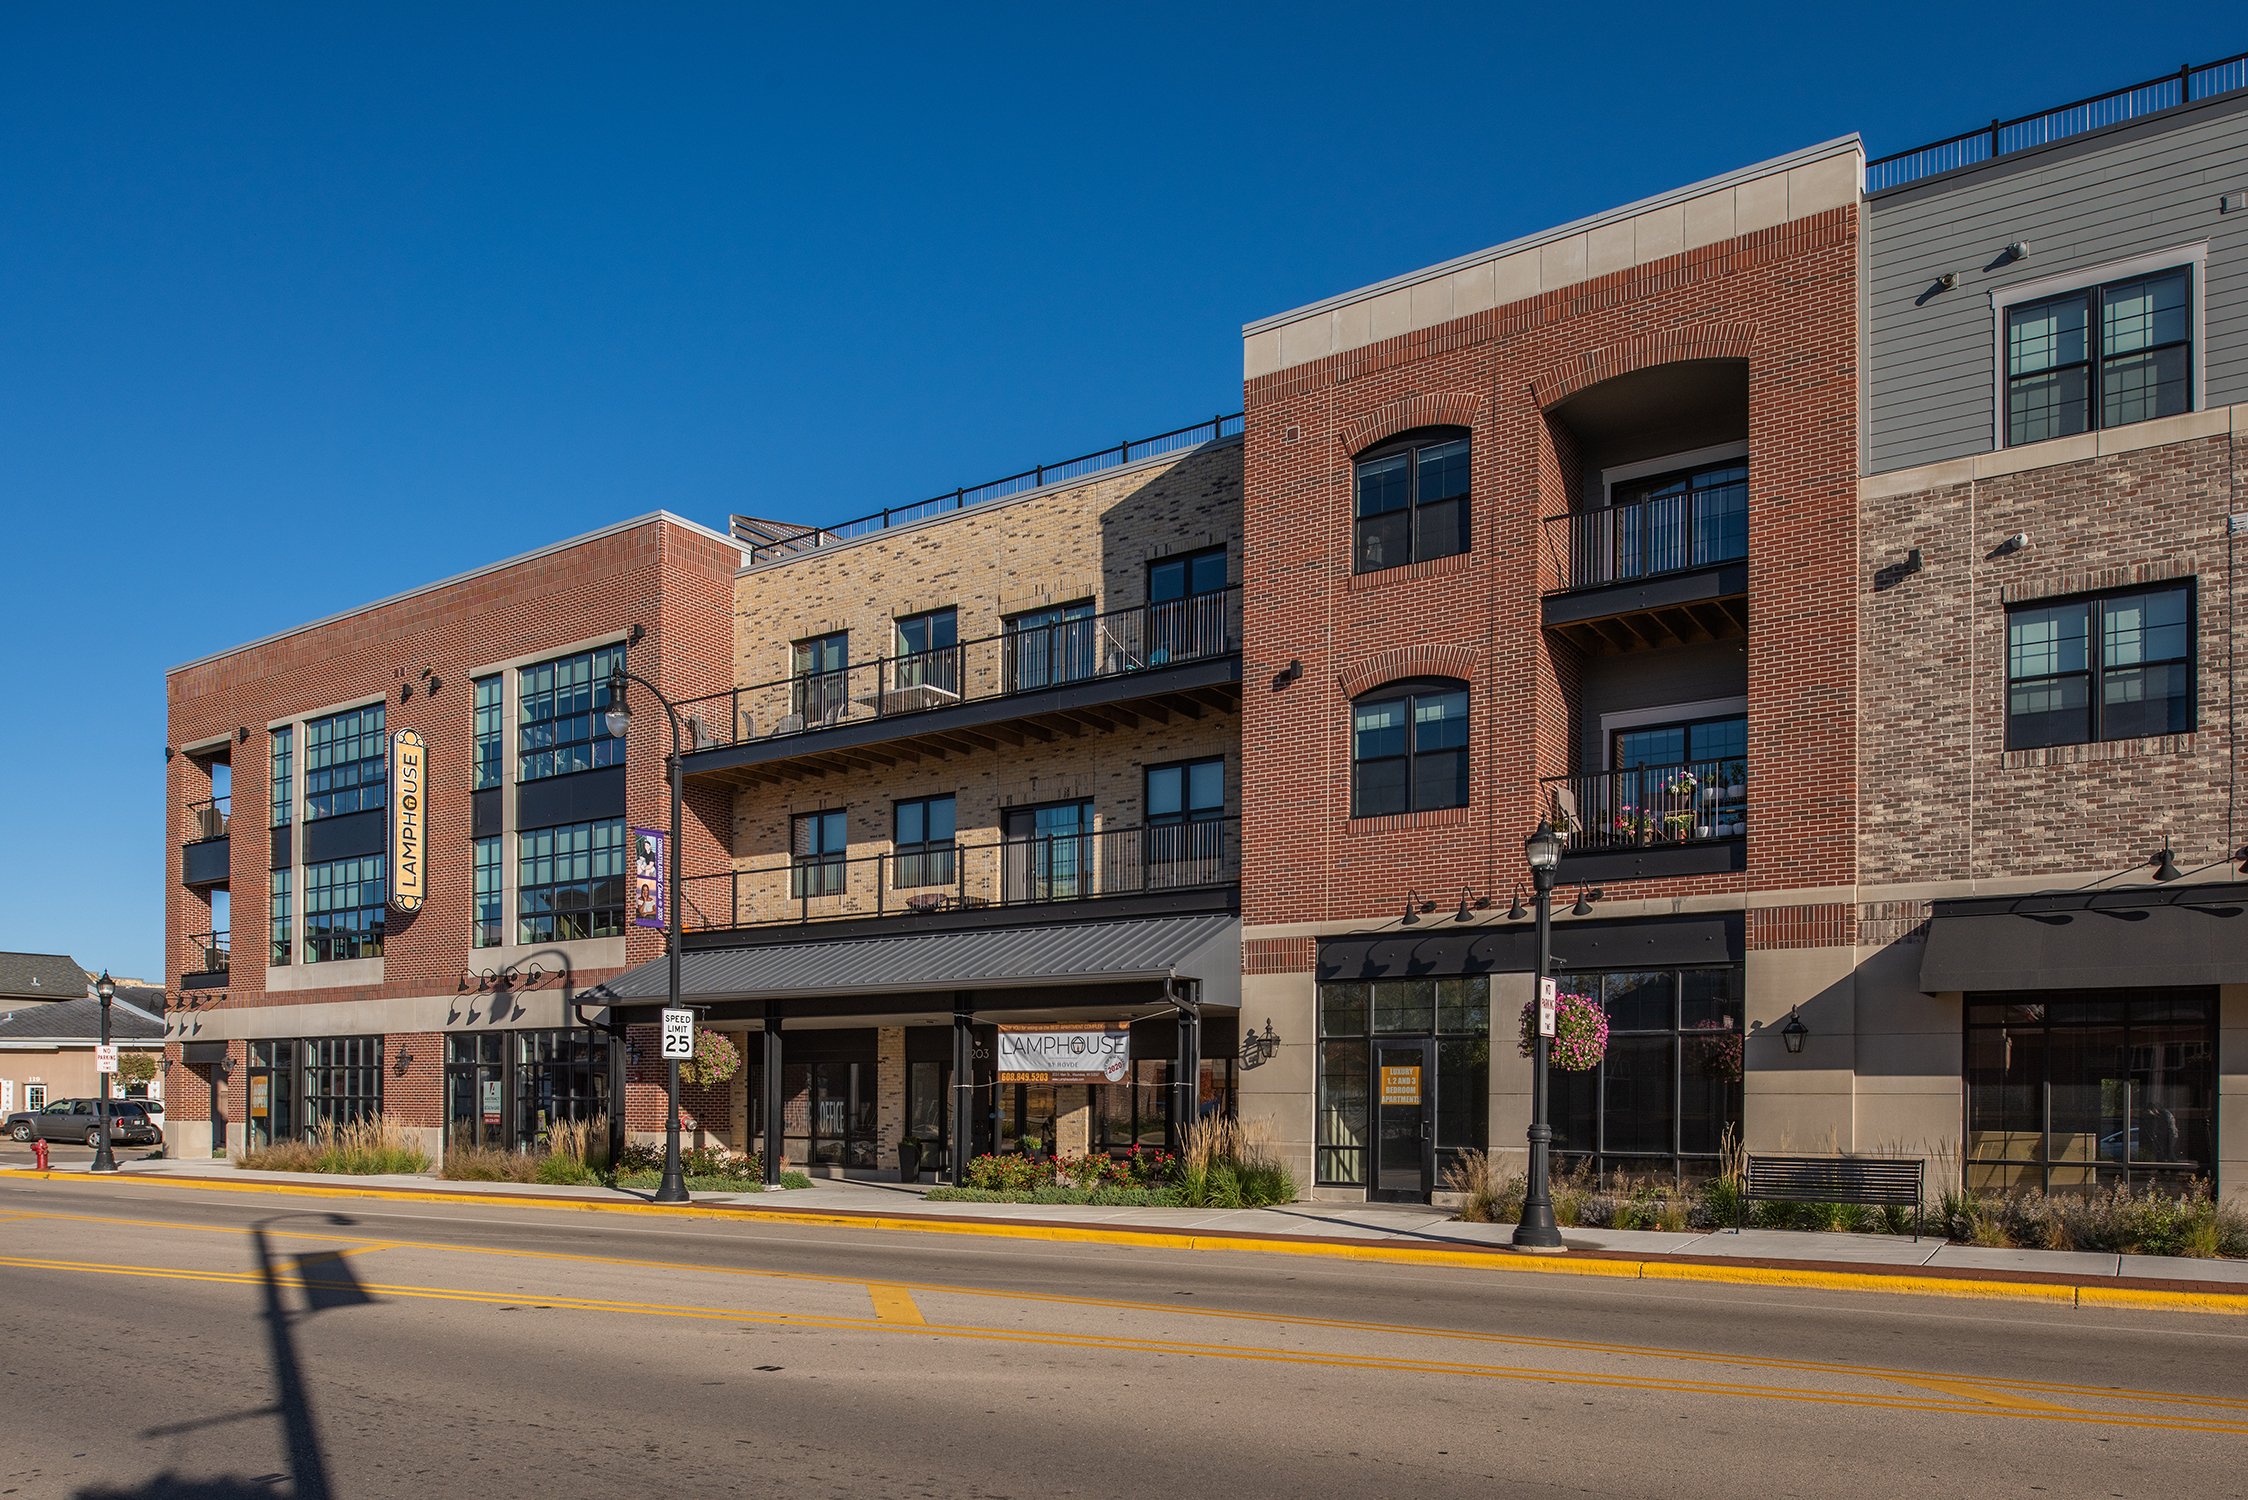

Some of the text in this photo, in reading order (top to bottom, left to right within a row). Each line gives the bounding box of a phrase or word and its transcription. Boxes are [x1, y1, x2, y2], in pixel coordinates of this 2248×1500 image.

[402, 752, 418, 887] LAMPHOUSE
[665, 1014, 691, 1023] SPEED
[667, 1025, 688, 1033] LIMIT
[665, 1034, 690, 1053] 25
[1002, 1035, 1125, 1055] LAMPHOUSE
[971, 1048, 989, 1059] 203
[1108, 1061, 1122, 1074] 2020
[1001, 1072, 1049, 1082] 608.849.5203
[1393, 1077, 1397, 1085] 2
[1398, 1077, 1410, 1085] AND
[1411, 1077, 1416, 1085] 3
[1385, 1086, 1416, 1094] BEDROOM
[253, 1096, 268, 1108] OPEN
[1381, 1095, 1422, 1103] APARTMENTS
[820, 1101, 844, 1133] OFFICE
